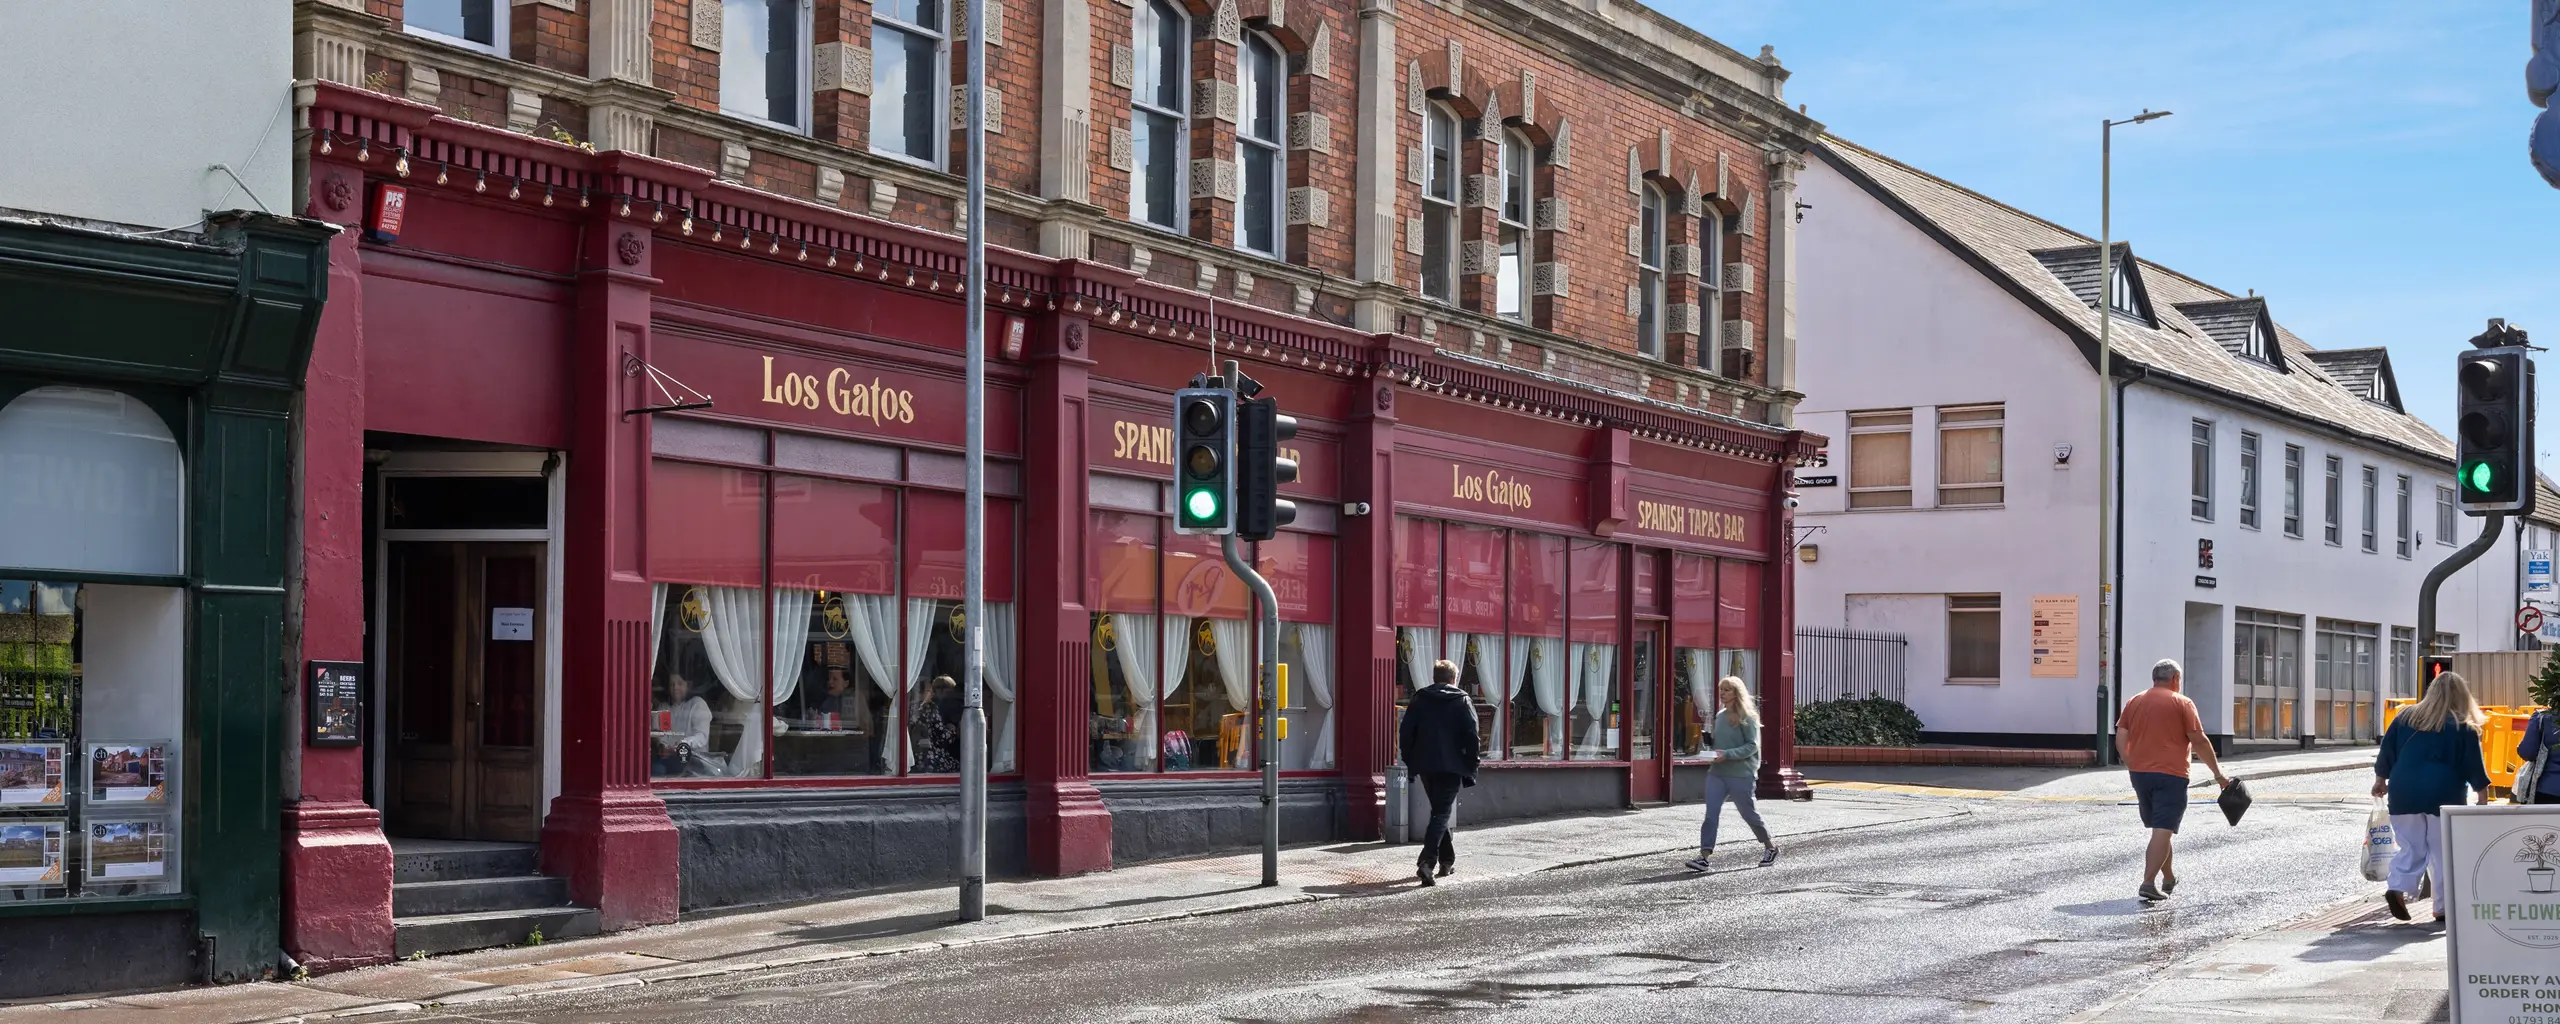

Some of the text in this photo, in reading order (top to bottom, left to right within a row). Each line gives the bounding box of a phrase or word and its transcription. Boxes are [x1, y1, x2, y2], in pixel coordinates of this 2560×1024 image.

[386, 191, 404, 208] PFS
[382, 210, 401, 219] SYSTEMS
[1013, 321, 1025, 334] PFS
[762, 355, 915, 427] Los Gatos
[1114, 419, 1175, 466] SPANI
[1452, 463, 1532, 513] Los Gatos
[1638, 500, 1745, 543] SPANISH TAPAS BAR
[2530, 551, 2549, 560] Yak
[2472, 904, 2502, 920] THE
[2468, 974, 2540, 985] DELIVERY
[2478, 988, 2530, 999] ORDER
[2508, 1016, 2543, 1024] 01793
